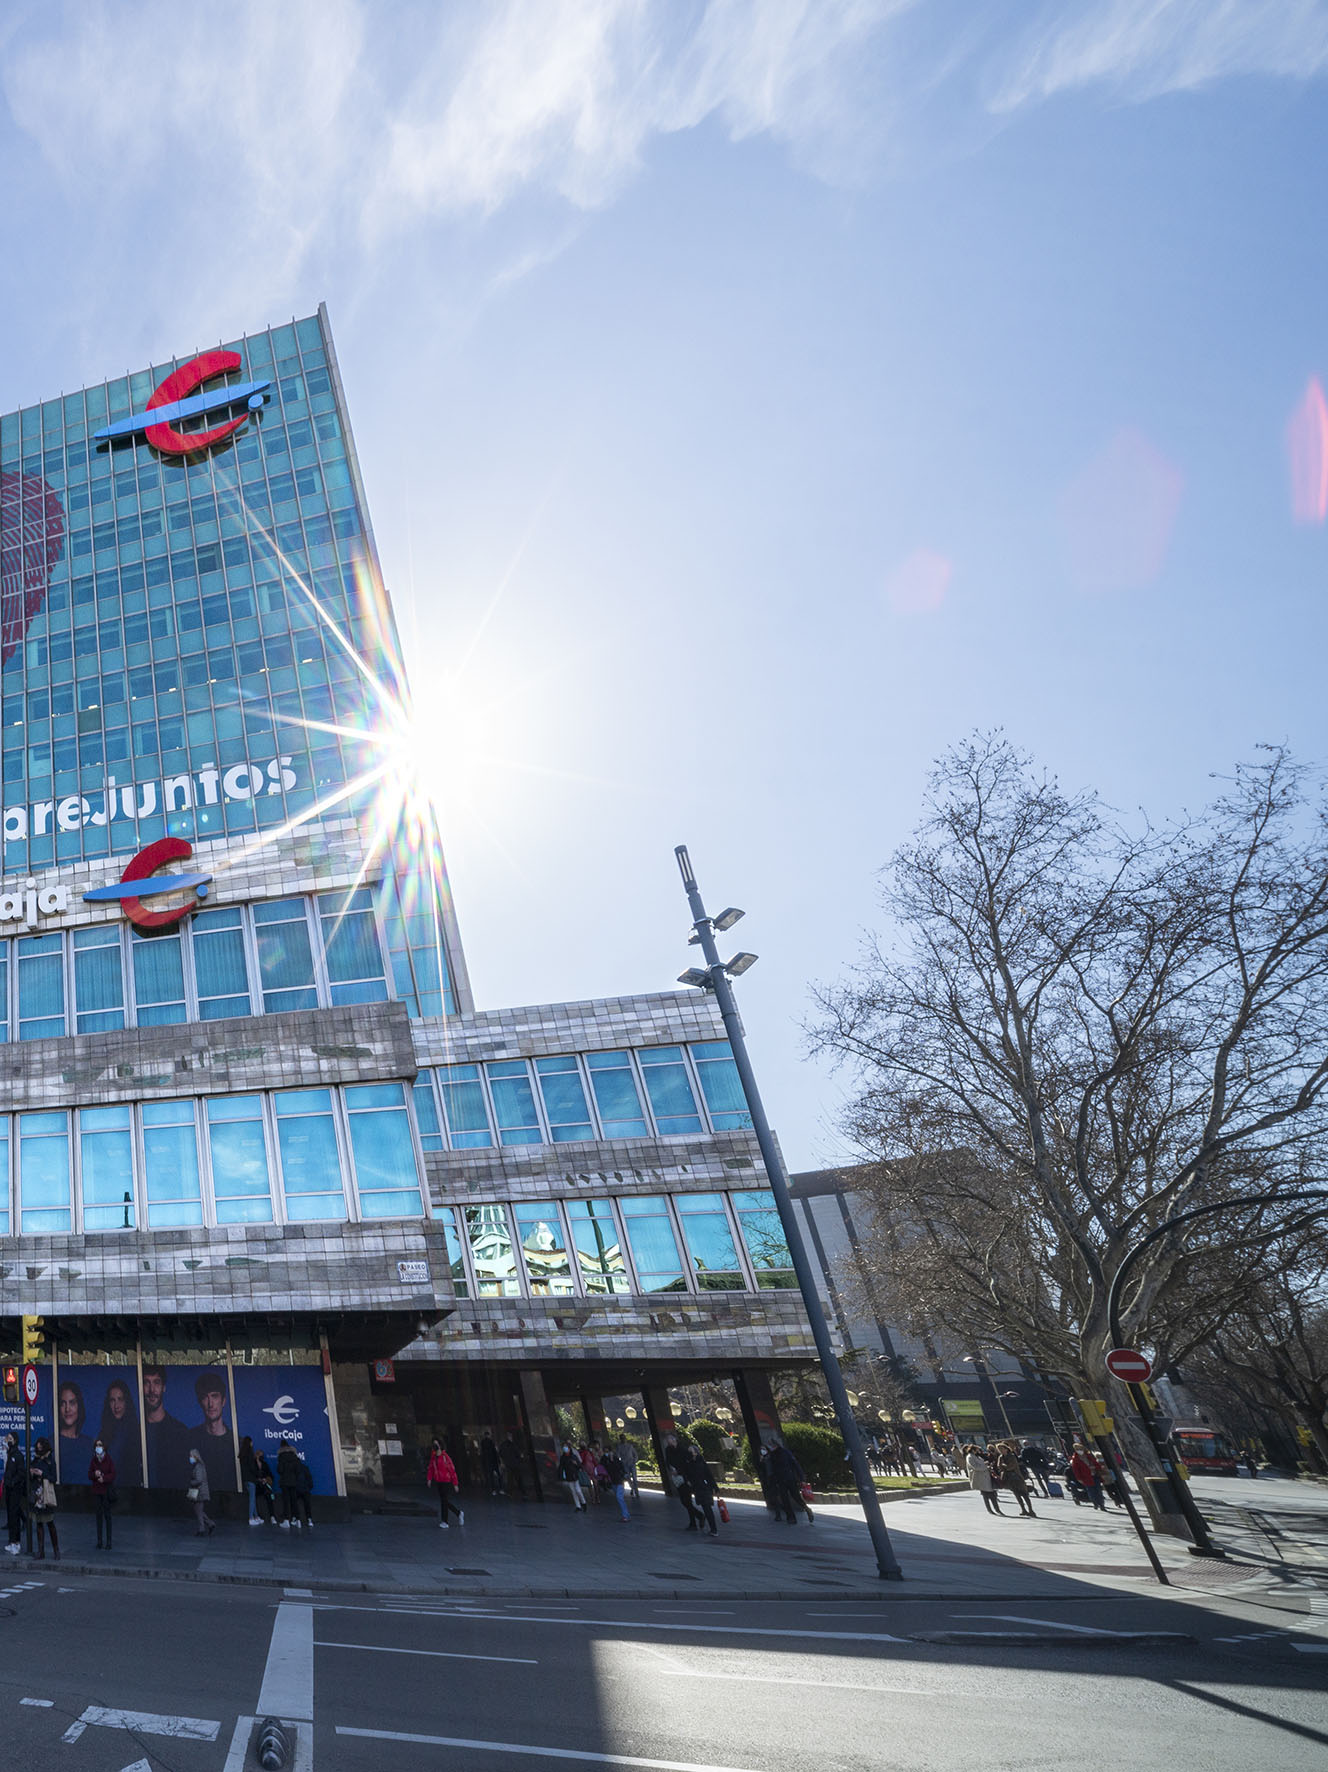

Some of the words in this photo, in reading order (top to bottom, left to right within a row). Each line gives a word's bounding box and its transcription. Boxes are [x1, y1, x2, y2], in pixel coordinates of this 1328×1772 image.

[27, 1379, 37, 1392] 30
[10, 1423, 35, 1431] CABEA
[264, 1428, 304, 1442] iberCaja
